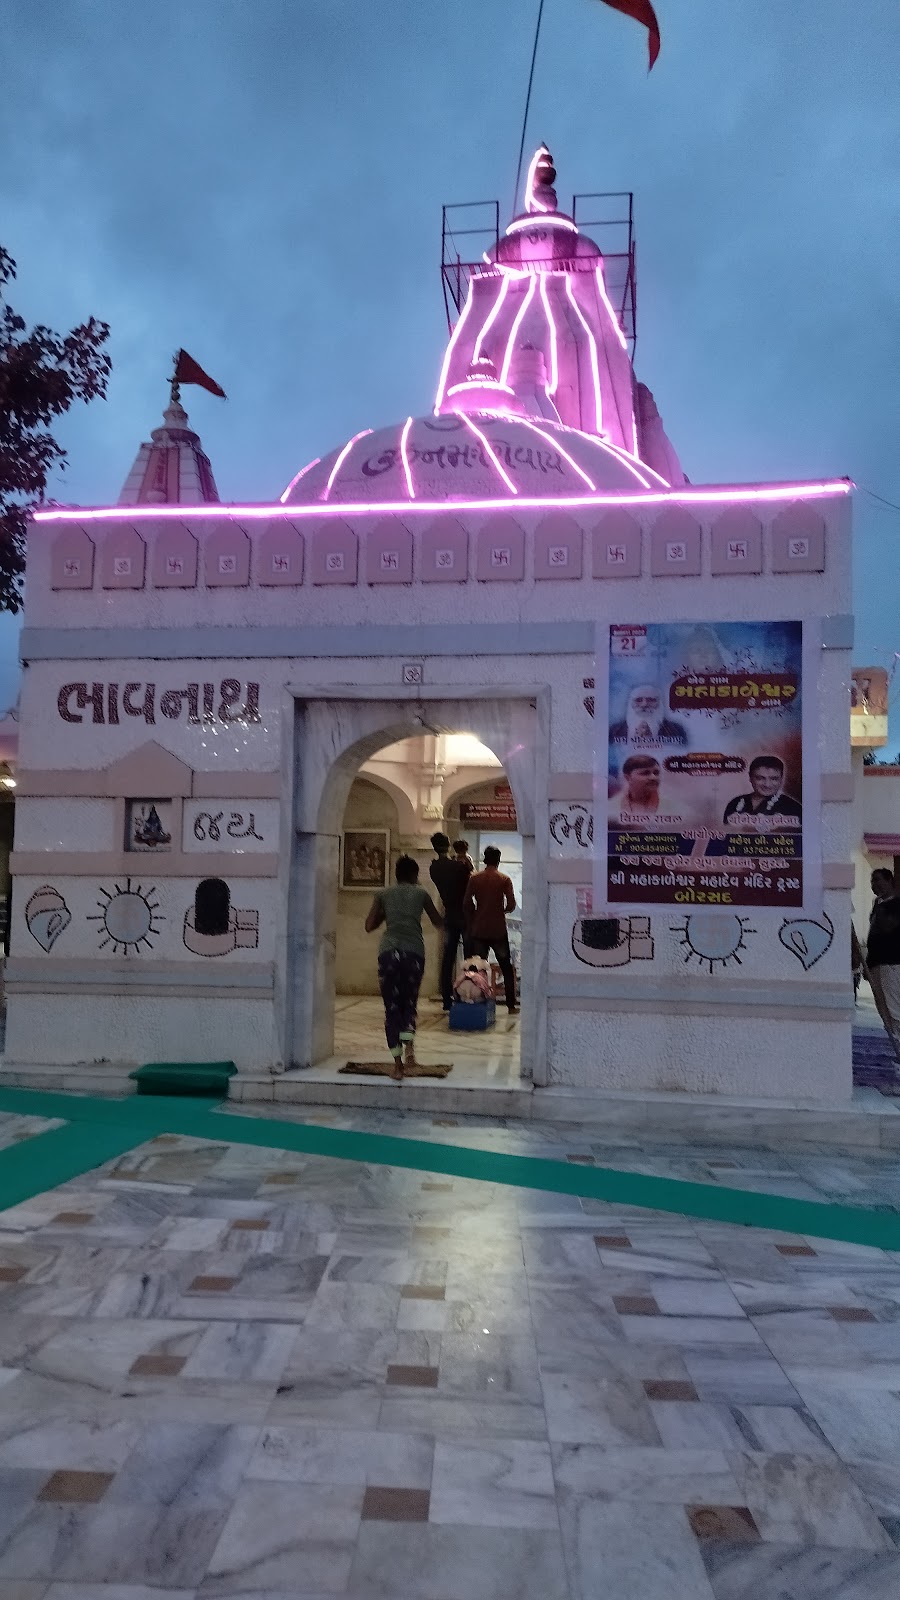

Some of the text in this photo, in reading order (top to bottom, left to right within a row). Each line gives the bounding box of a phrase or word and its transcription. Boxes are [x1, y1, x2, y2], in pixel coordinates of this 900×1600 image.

[621, 637, 636, 650] 21
[193, 811, 264, 841] જય
[610, 872, 625, 885] શ્રી
[629, 871, 695, 887] મહાકાળેશ્વર
[700, 873, 739, 888] મહાદેવ
[744, 873, 772, 888] મંદિર
[674, 887, 733, 903] બોરસદ
